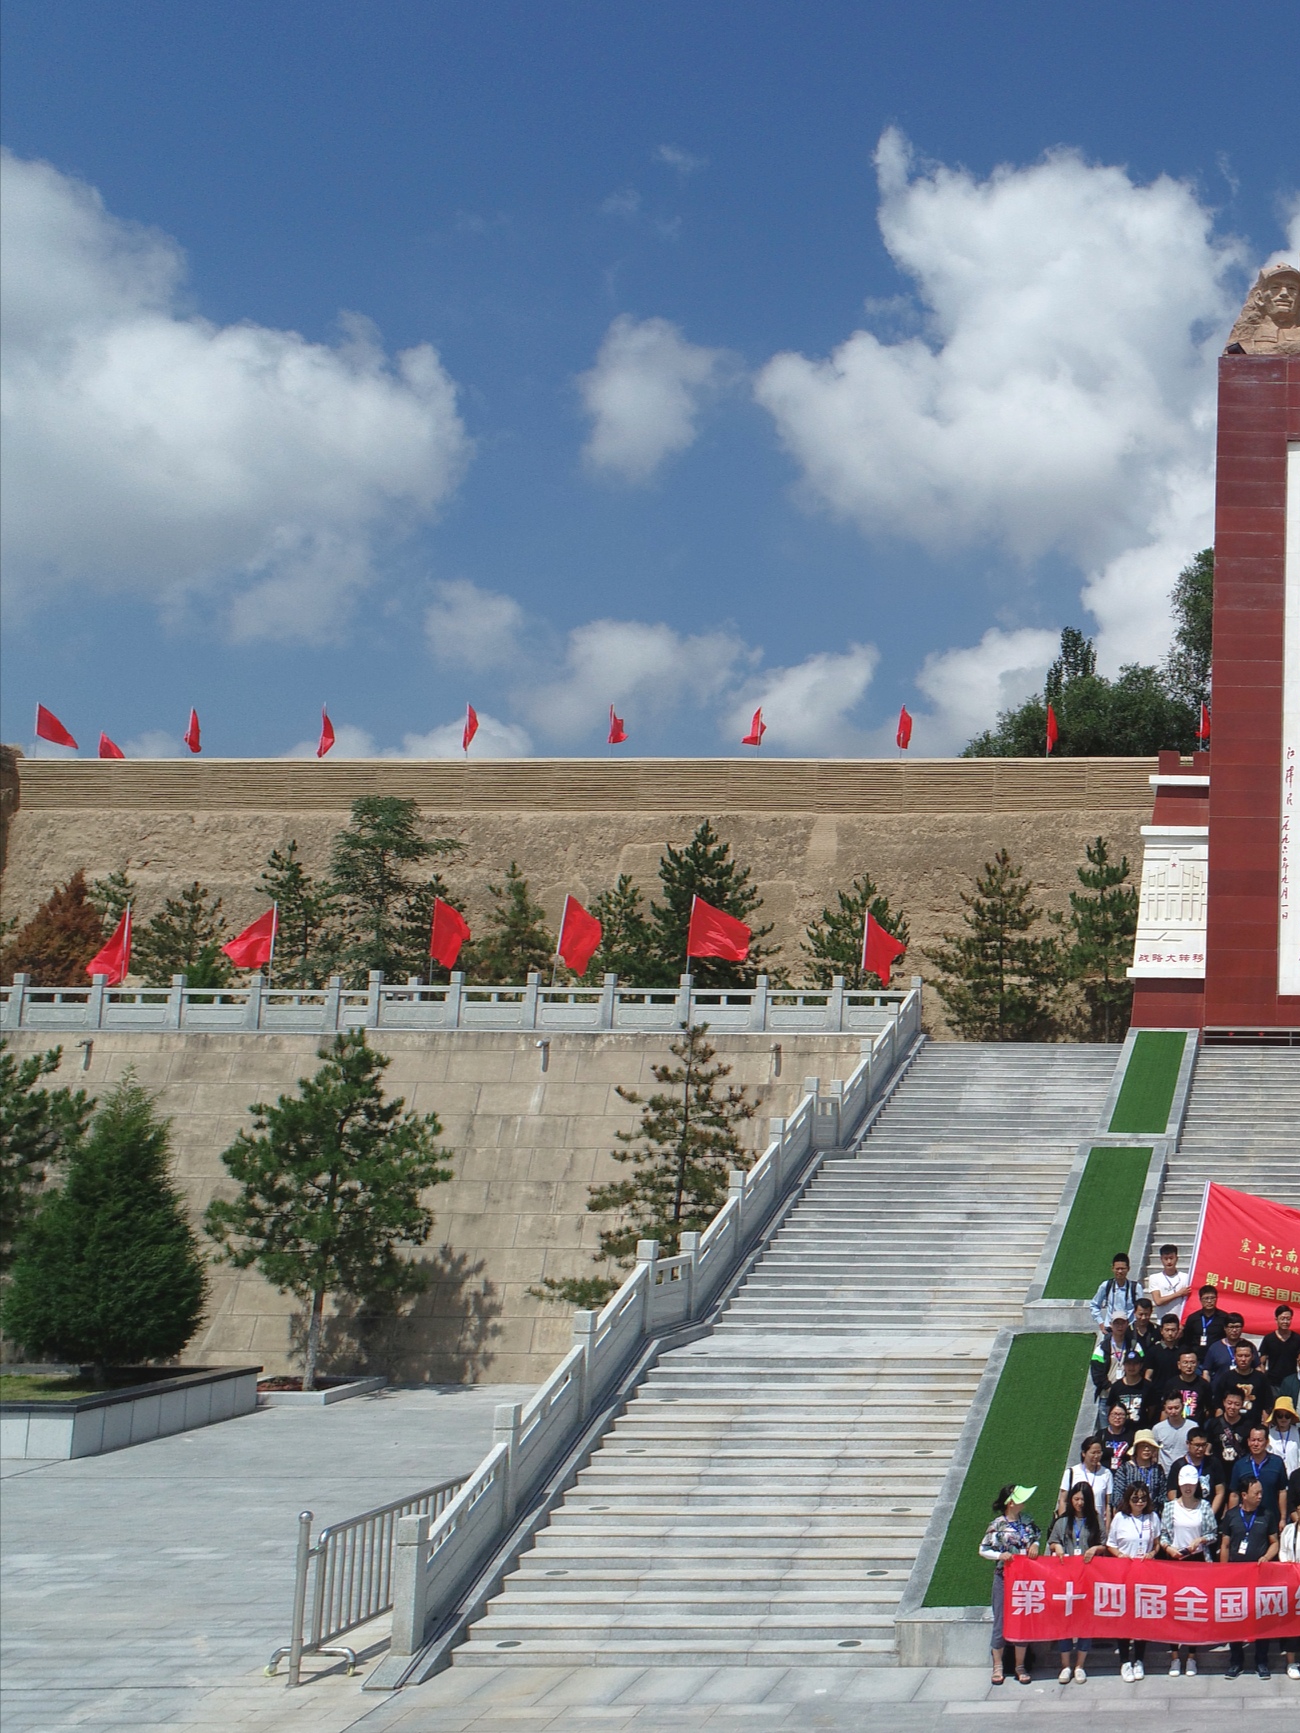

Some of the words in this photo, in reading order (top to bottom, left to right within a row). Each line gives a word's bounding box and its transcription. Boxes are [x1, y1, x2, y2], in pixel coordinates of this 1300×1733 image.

[1138, 953, 1205, 963] 战略大转移
[1239, 1237, 1298, 1263] 塞上江南
